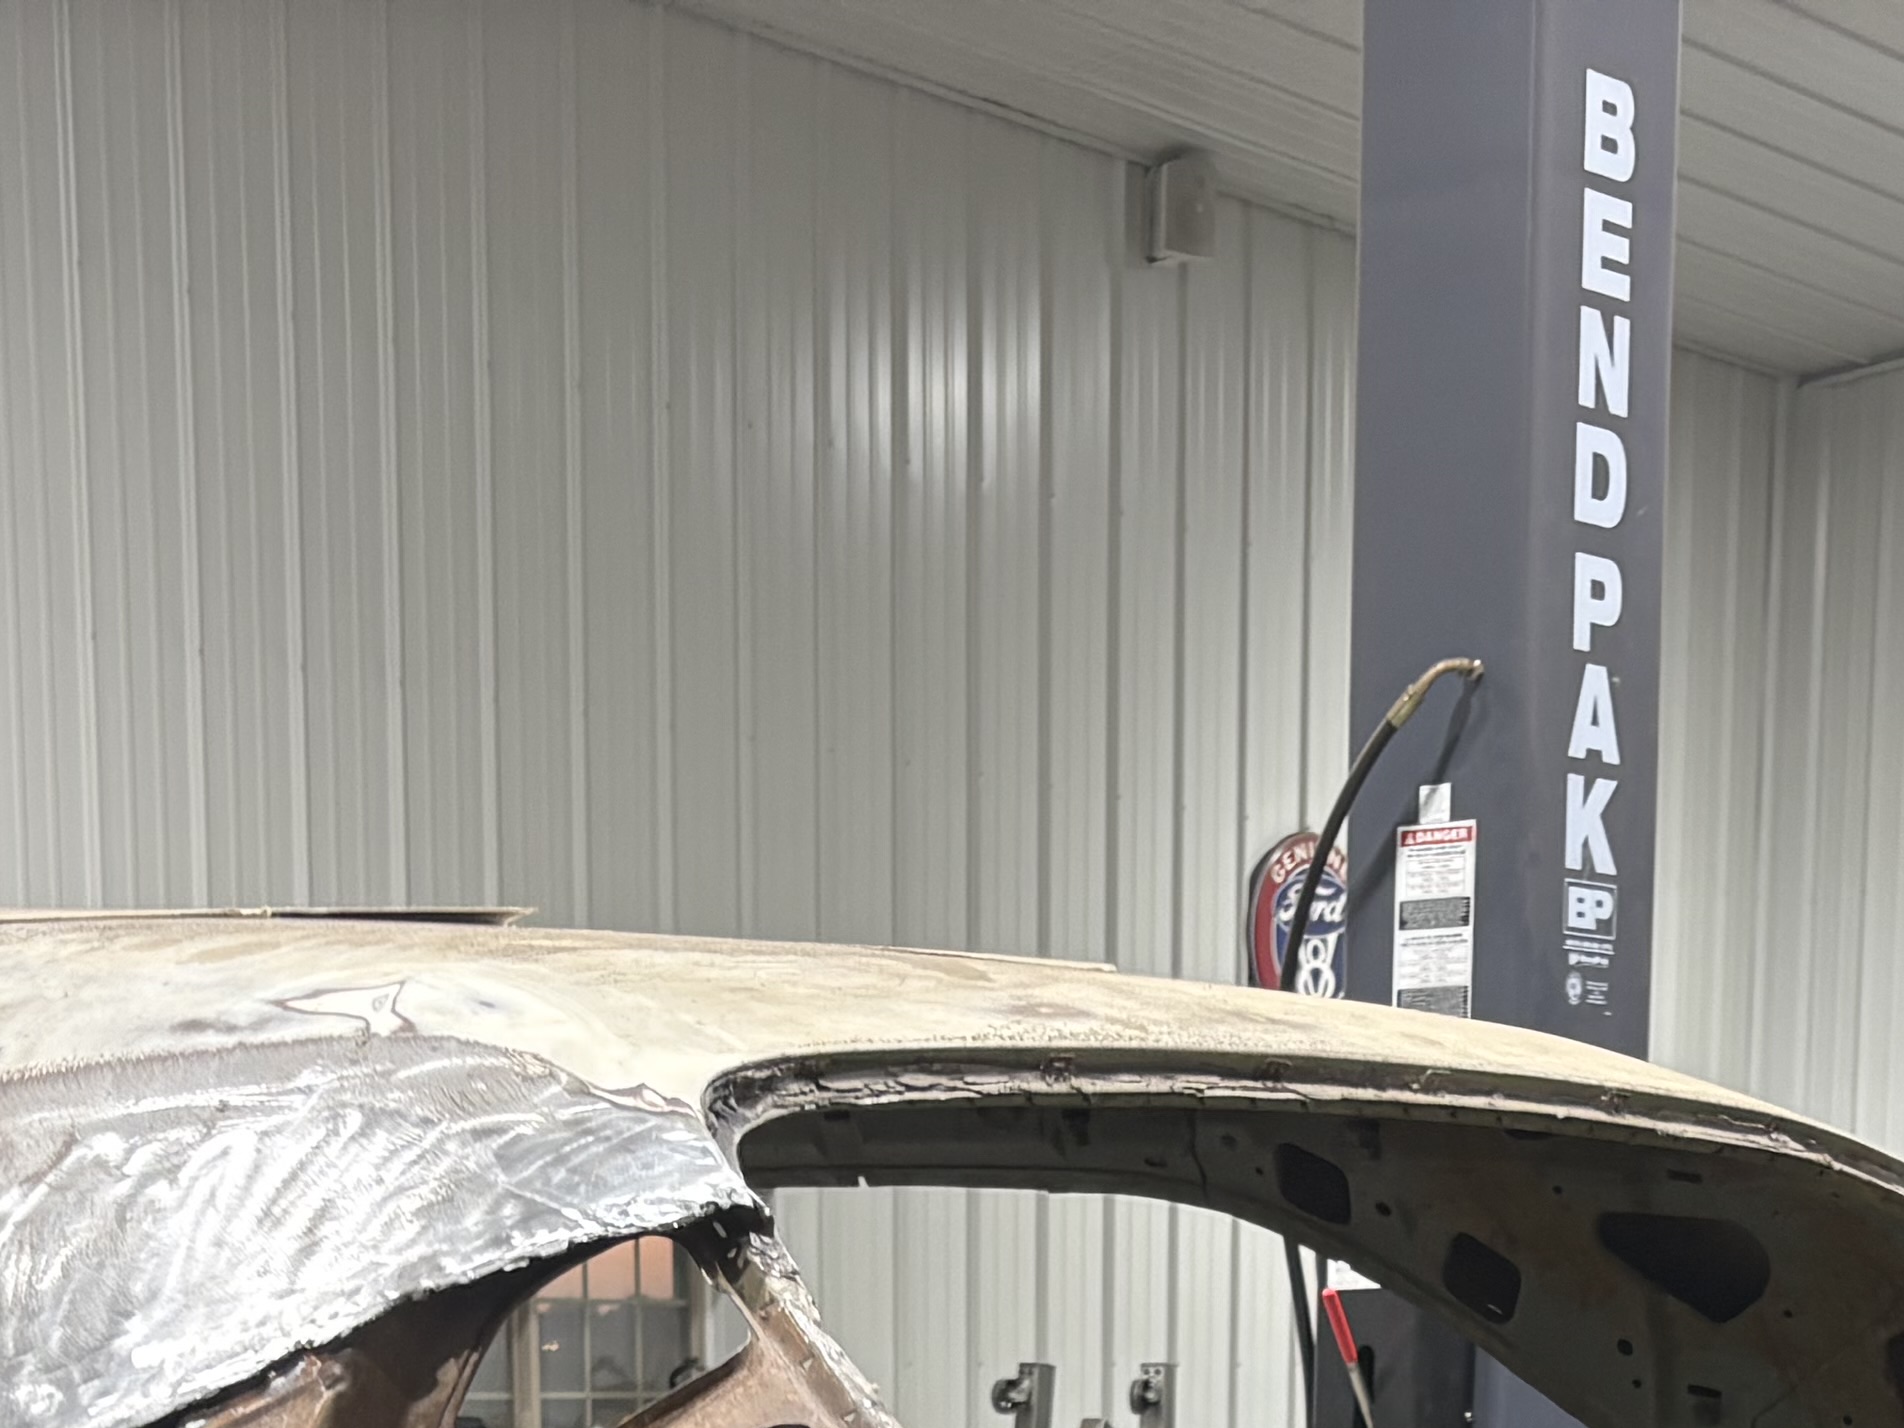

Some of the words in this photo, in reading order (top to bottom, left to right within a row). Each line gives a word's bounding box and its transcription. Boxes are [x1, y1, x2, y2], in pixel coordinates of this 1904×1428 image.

[1564, 67, 1637, 876] BENDPAK
[1415, 828, 1468, 843] DANGER
[1568, 886, 1613, 930] BP
